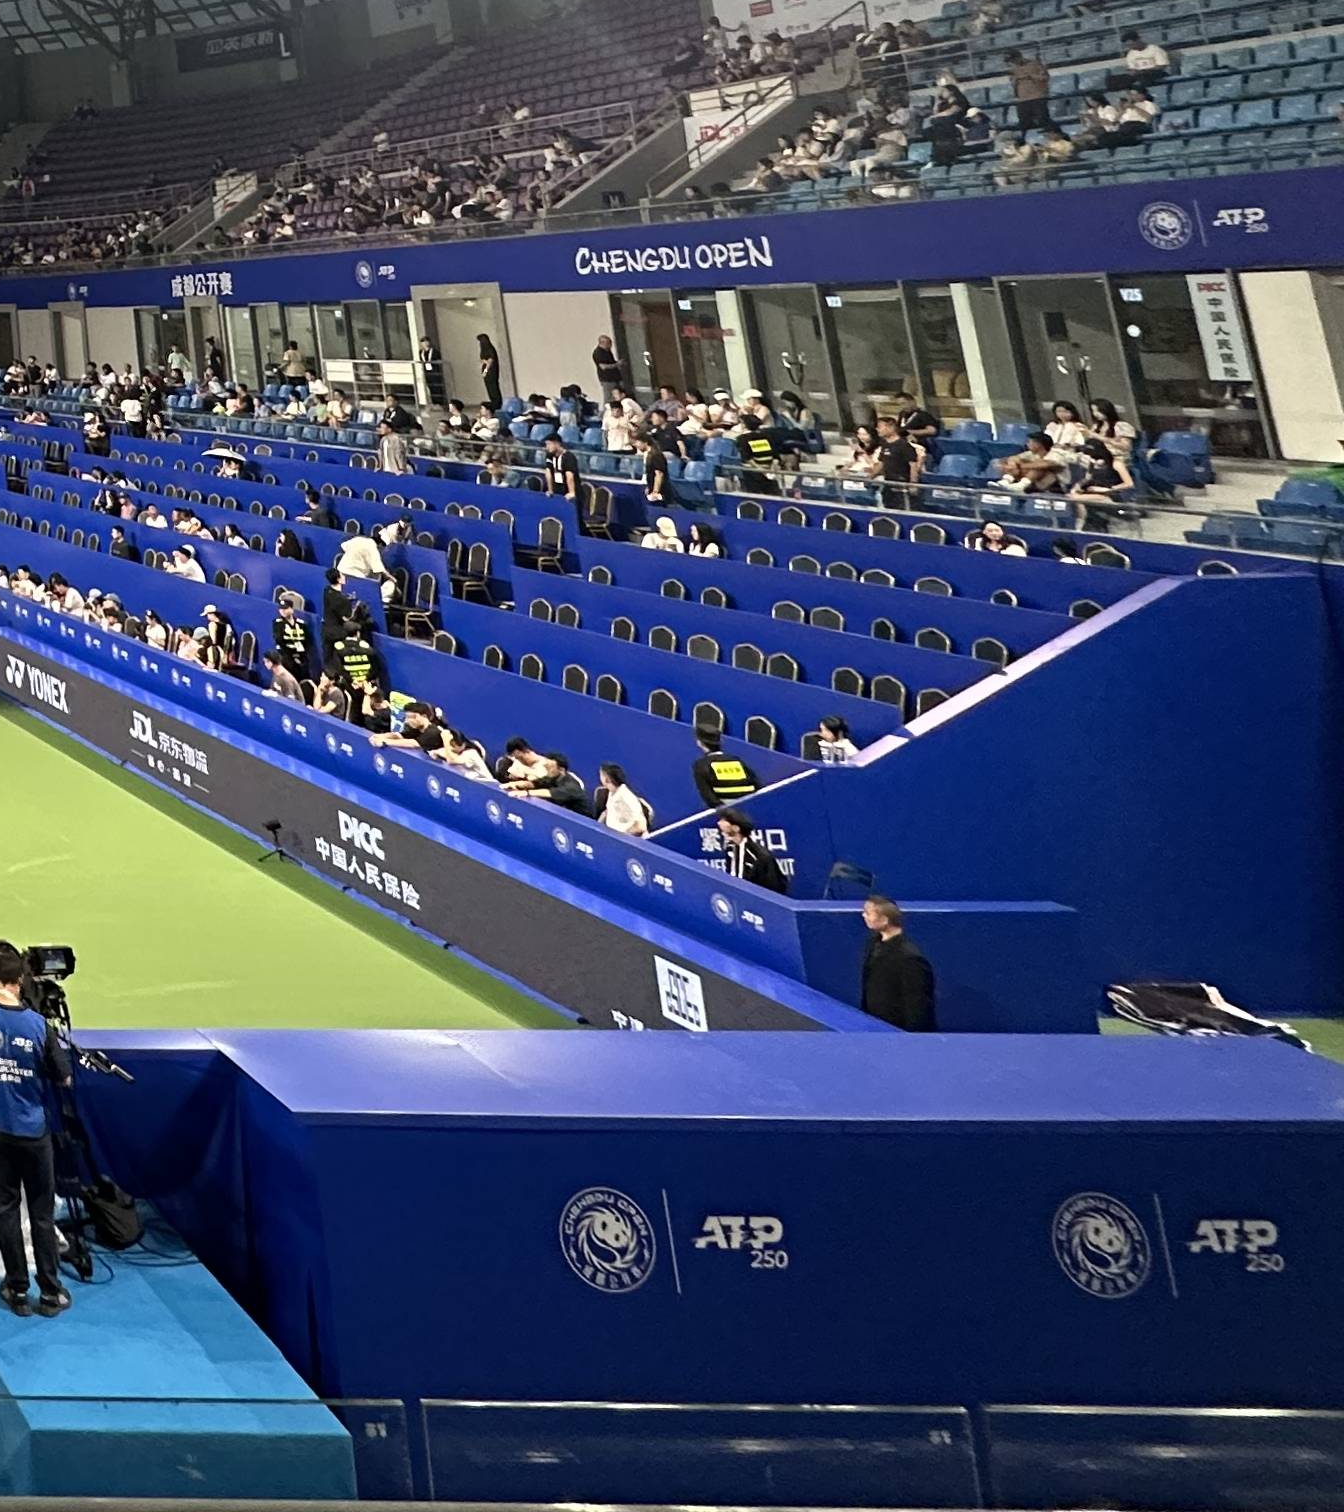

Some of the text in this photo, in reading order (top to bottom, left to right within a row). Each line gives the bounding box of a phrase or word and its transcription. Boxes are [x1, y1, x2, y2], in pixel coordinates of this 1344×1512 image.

[279, 32, 291, 57] L
[1213, 207, 1265, 227] ATP
[575, 235, 773, 275] CHENGDU OPEN
[171, 272, 233, 297] 成都公开赛
[1206, 297, 1240, 378] 中国人民保险
[26, 663, 69, 714] YONEX
[129, 709, 159, 749] JDL
[158, 730, 209, 775] 京东物流
[338, 809, 385, 861] PICC
[314, 835, 421, 912] 中国人民保险
[741, 909, 764, 926] ATP
[564, 1192, 615, 1236] CHENGDU
[692, 1215, 784, 1249] ATP
[1186, 1219, 1278, 1254] ATP
[750, 1249, 790, 1268] 250
